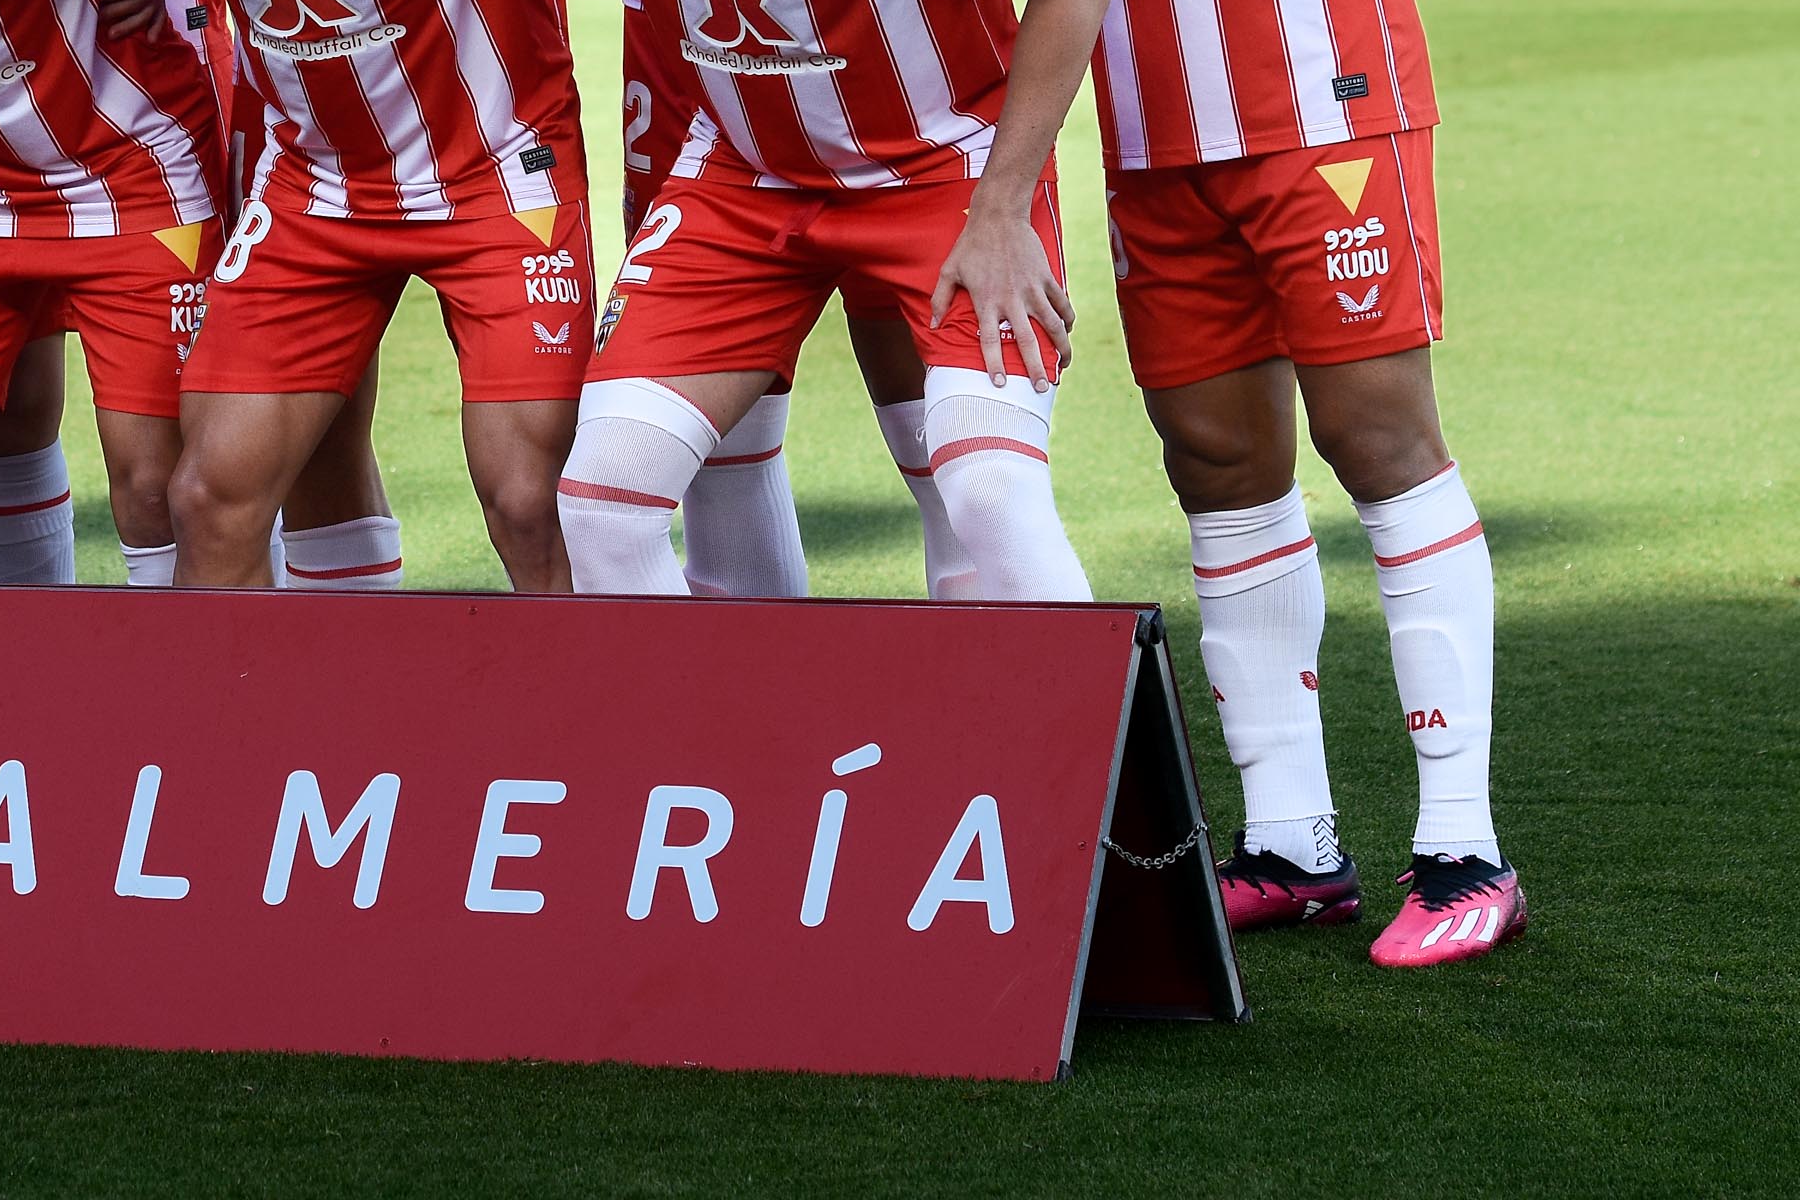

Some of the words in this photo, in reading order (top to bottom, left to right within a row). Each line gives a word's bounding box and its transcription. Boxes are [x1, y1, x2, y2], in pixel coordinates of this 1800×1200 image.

[253, 31, 299, 56] Khaled
[305, 34, 362, 57] Juffali
[368, 26, 401, 42] Co.
[1, 62, 33, 78] Co.
[685, 45, 738, 69] Khaled
[745, 54, 801, 70] Juffali
[808, 54, 843, 68] Co.
[214, 199, 272, 282] 8
[1324, 217, 1385, 251] كودو
[521, 249, 575, 275] كودو
[1326, 247, 1389, 281] KUDU
[525, 277, 581, 305] KUDU
[171, 306, 195, 332] KU
[1341, 310, 1383, 324] CASTORE
[535, 346, 573, 354] CASTORE
